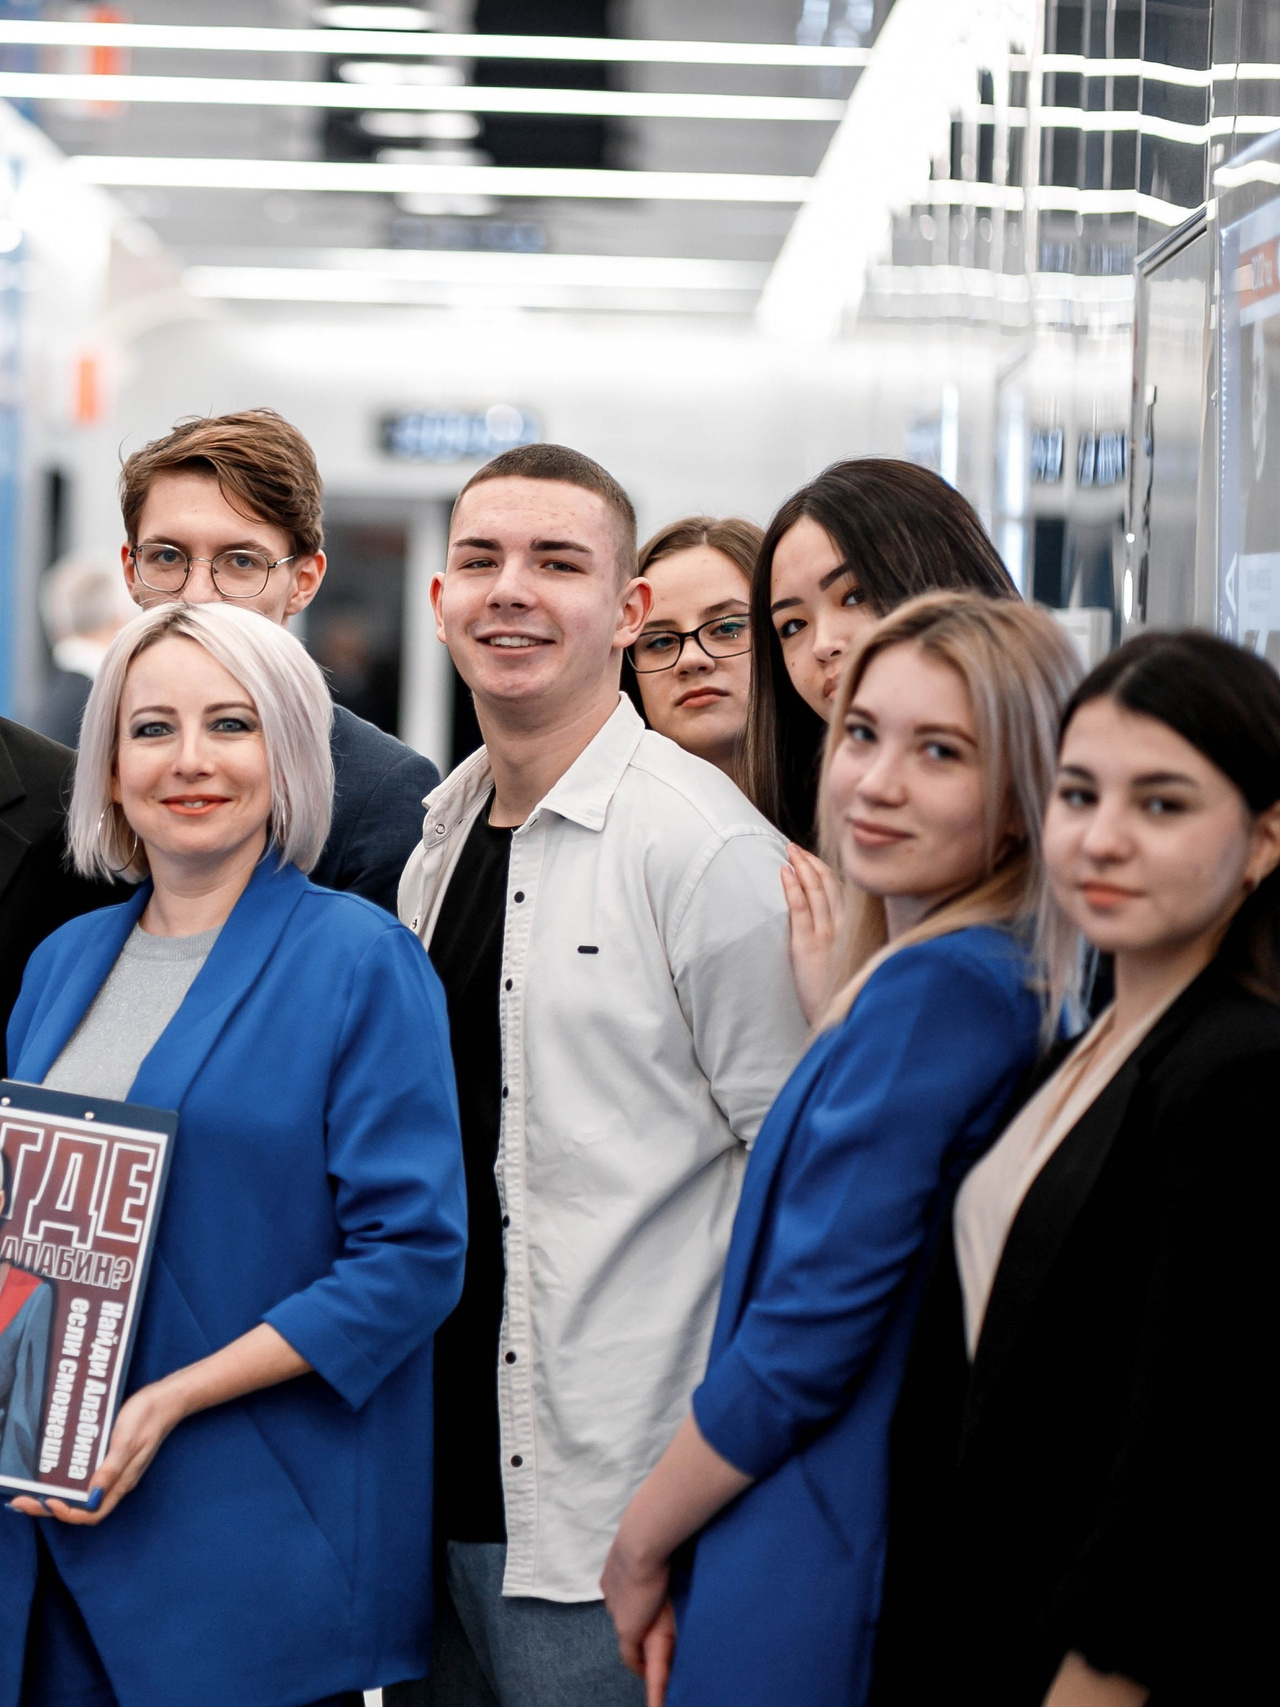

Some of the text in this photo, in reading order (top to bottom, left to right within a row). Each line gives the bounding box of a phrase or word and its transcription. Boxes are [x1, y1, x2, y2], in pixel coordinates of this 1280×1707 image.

[38, 1297, 90, 1473] если сможешь
[68, 1301, 124, 1480] Найди Алабина
